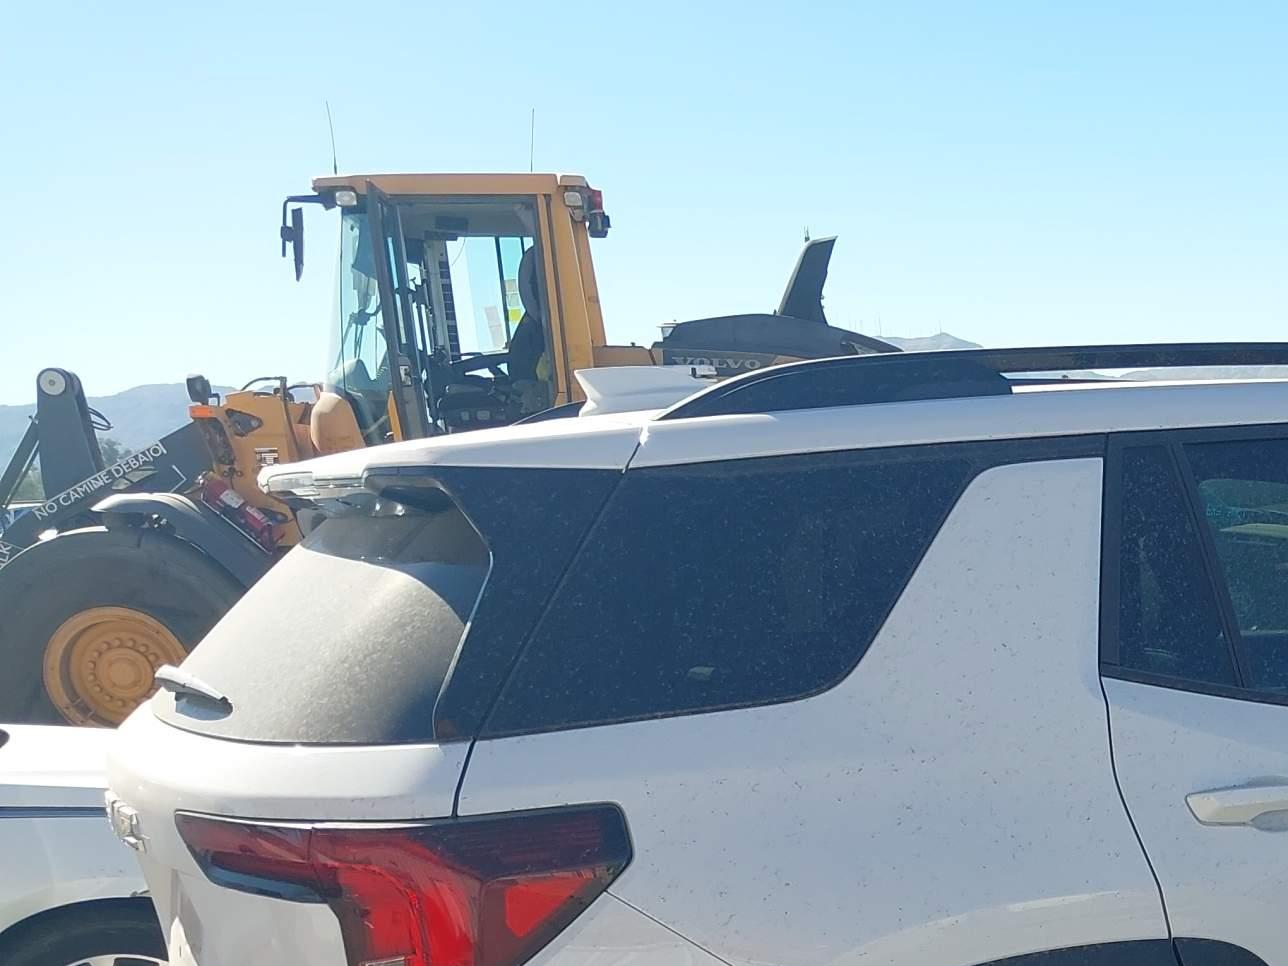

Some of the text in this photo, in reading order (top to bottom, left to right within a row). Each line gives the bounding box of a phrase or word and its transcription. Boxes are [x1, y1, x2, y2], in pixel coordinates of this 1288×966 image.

[671, 356, 761, 370] VOLVO
[32, 444, 162, 521] NO CAMINE DEBAJO
